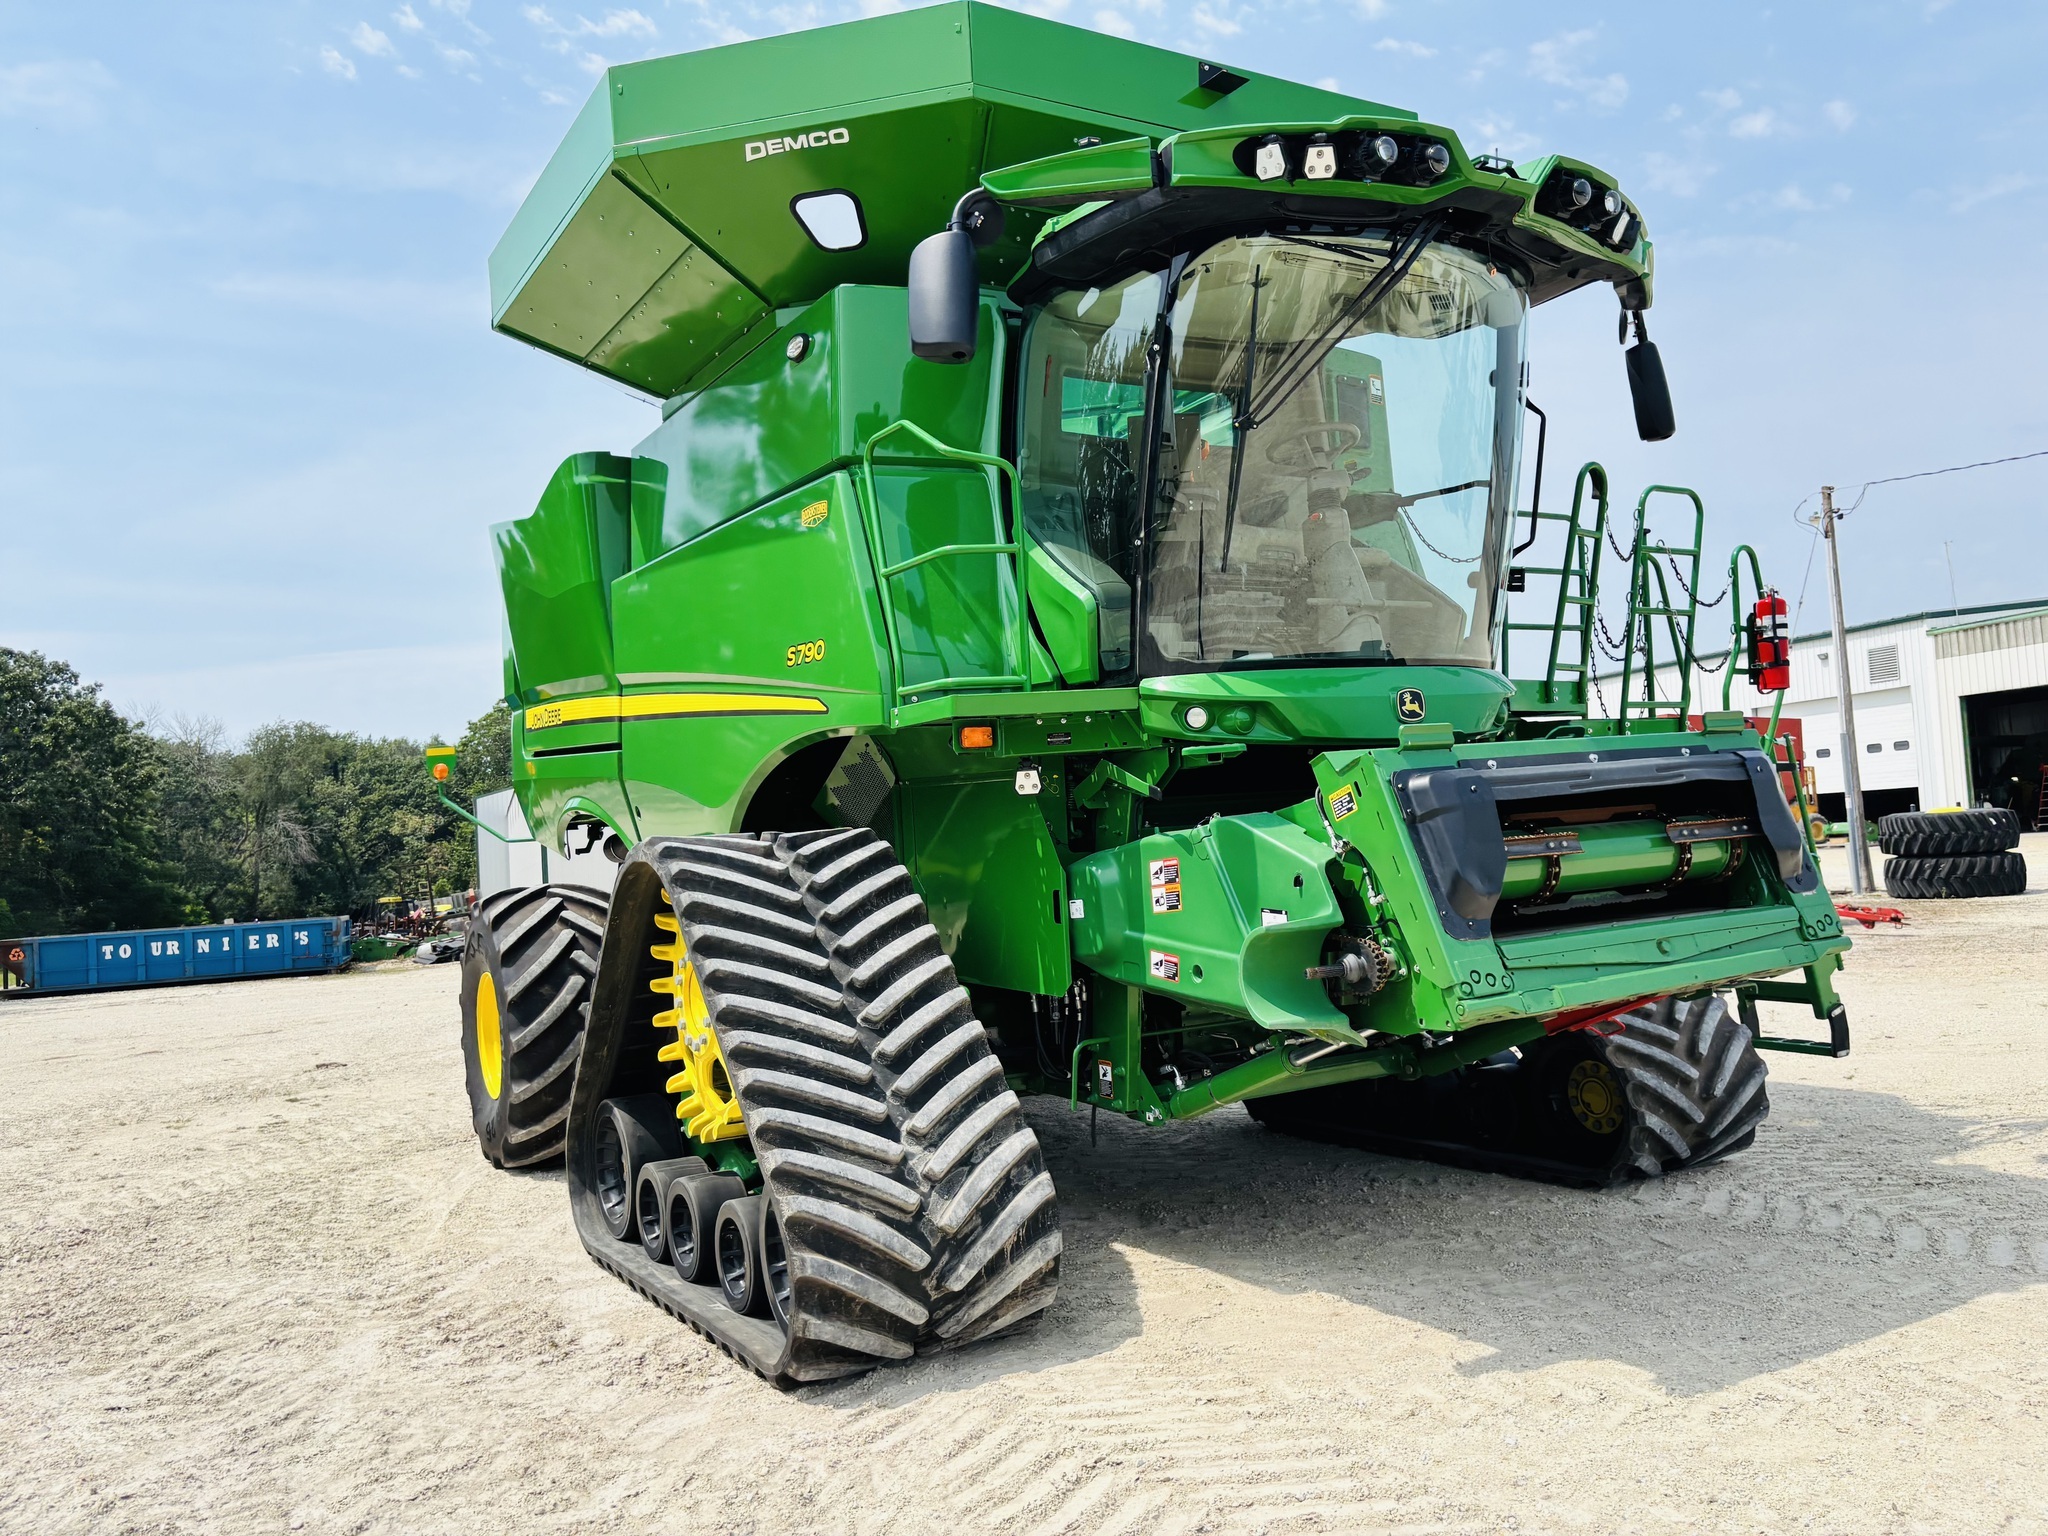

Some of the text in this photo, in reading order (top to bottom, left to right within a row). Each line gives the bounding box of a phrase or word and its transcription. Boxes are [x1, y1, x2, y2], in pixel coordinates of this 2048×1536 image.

[745, 127, 850, 162] DEMCO
[787, 639, 825, 667] S790
[545, 708, 562, 724] DEERE
